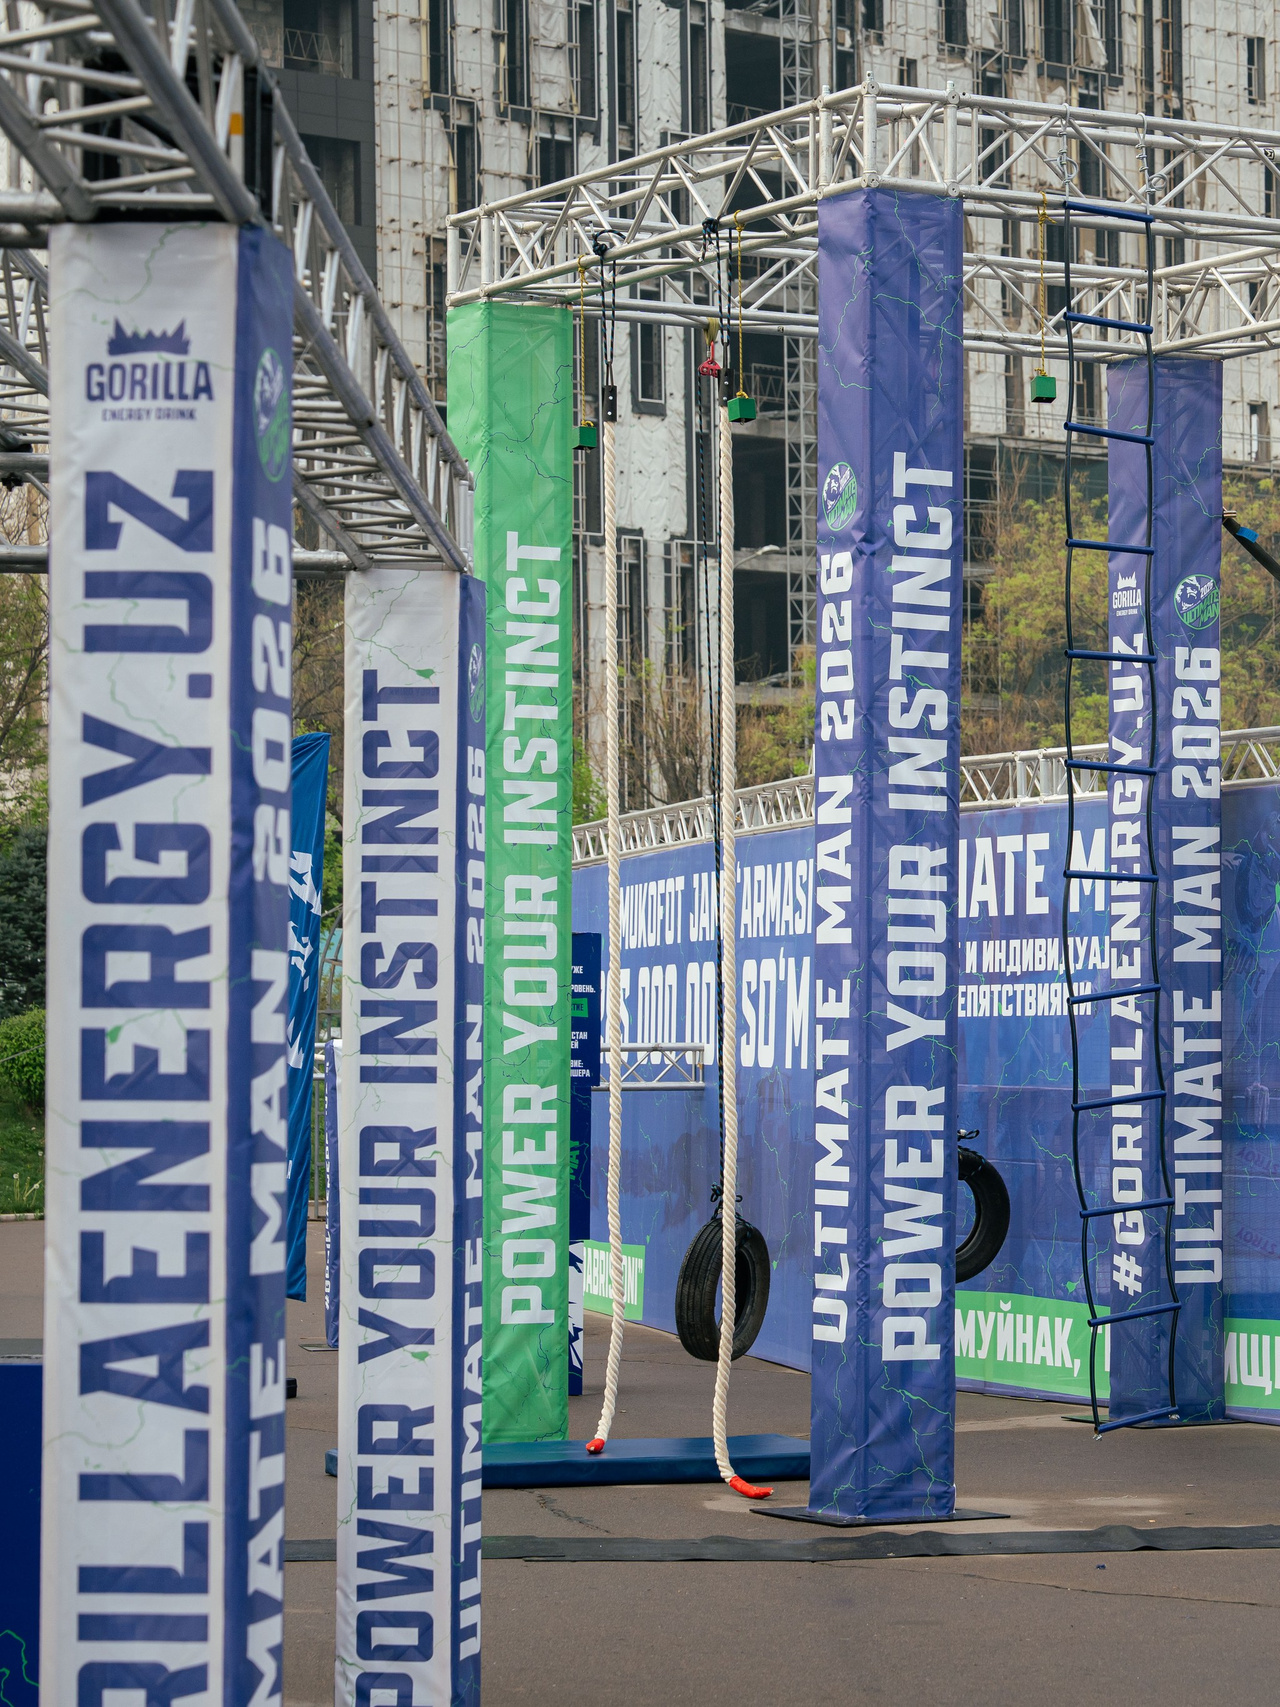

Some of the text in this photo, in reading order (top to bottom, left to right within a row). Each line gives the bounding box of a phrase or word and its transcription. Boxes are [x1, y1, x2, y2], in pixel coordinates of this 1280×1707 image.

[86, 362, 214, 402] GORILLA
[1113, 589, 1142, 609] GORILLA
[252, 518, 291, 886] 2026
[501, 531, 562, 1325] POWER YOUR INSTINCT
[620, 875, 685, 949] MUKOFOT
[740, 947, 811, 1069] SO'M
[813, 551, 855, 1342] ULTIMATE MAN 2026
[882, 451, 953, 1361] POWER YOUR INSTINCT
[1111, 632, 1144, 1297] #GORILLAENERGY.UZ
[1172, 646, 1222, 1284] ULTIMATE MAN 2026
[76, 470, 214, 1707] RILLAENERGY.UZ
[250, 950, 288, 1275] MAN
[356, 669, 440, 1707] POWER YOUR INSTINCT
[459, 747, 486, 1660] ULTIMATE MAN 2026
[955, 1300, 1081, 1377] МУЙНАК,
